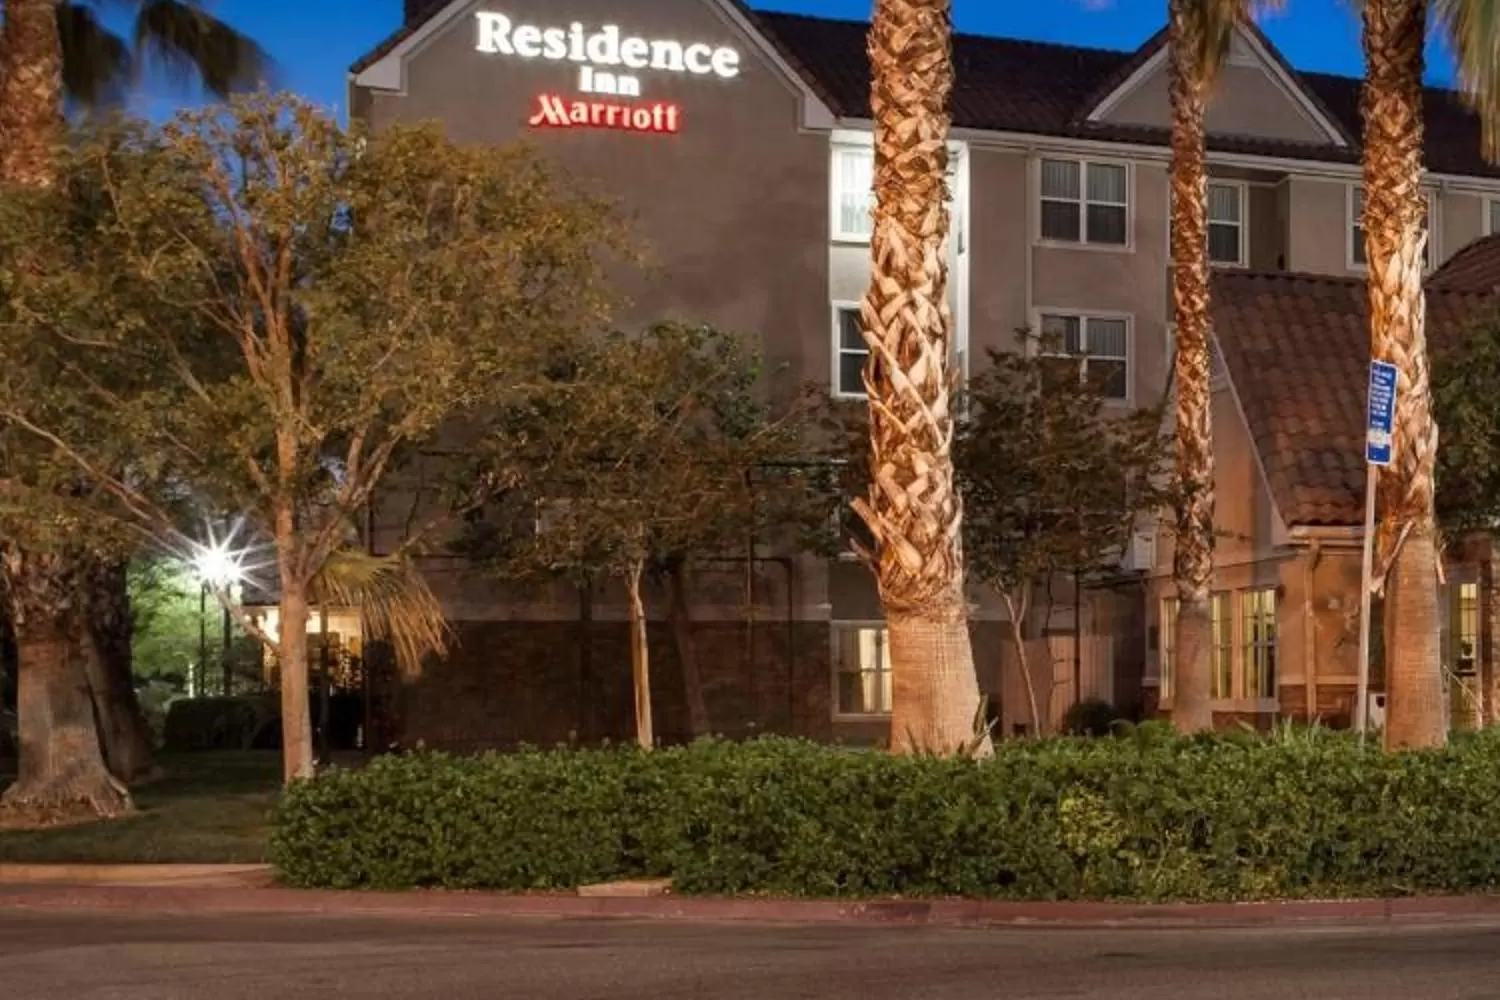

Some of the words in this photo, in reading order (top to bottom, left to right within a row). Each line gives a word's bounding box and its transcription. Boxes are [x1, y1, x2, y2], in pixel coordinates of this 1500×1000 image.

[475, 11, 740, 77] Residence
[579, 66, 640, 97] Inn
[528, 94, 678, 132] Marriott
